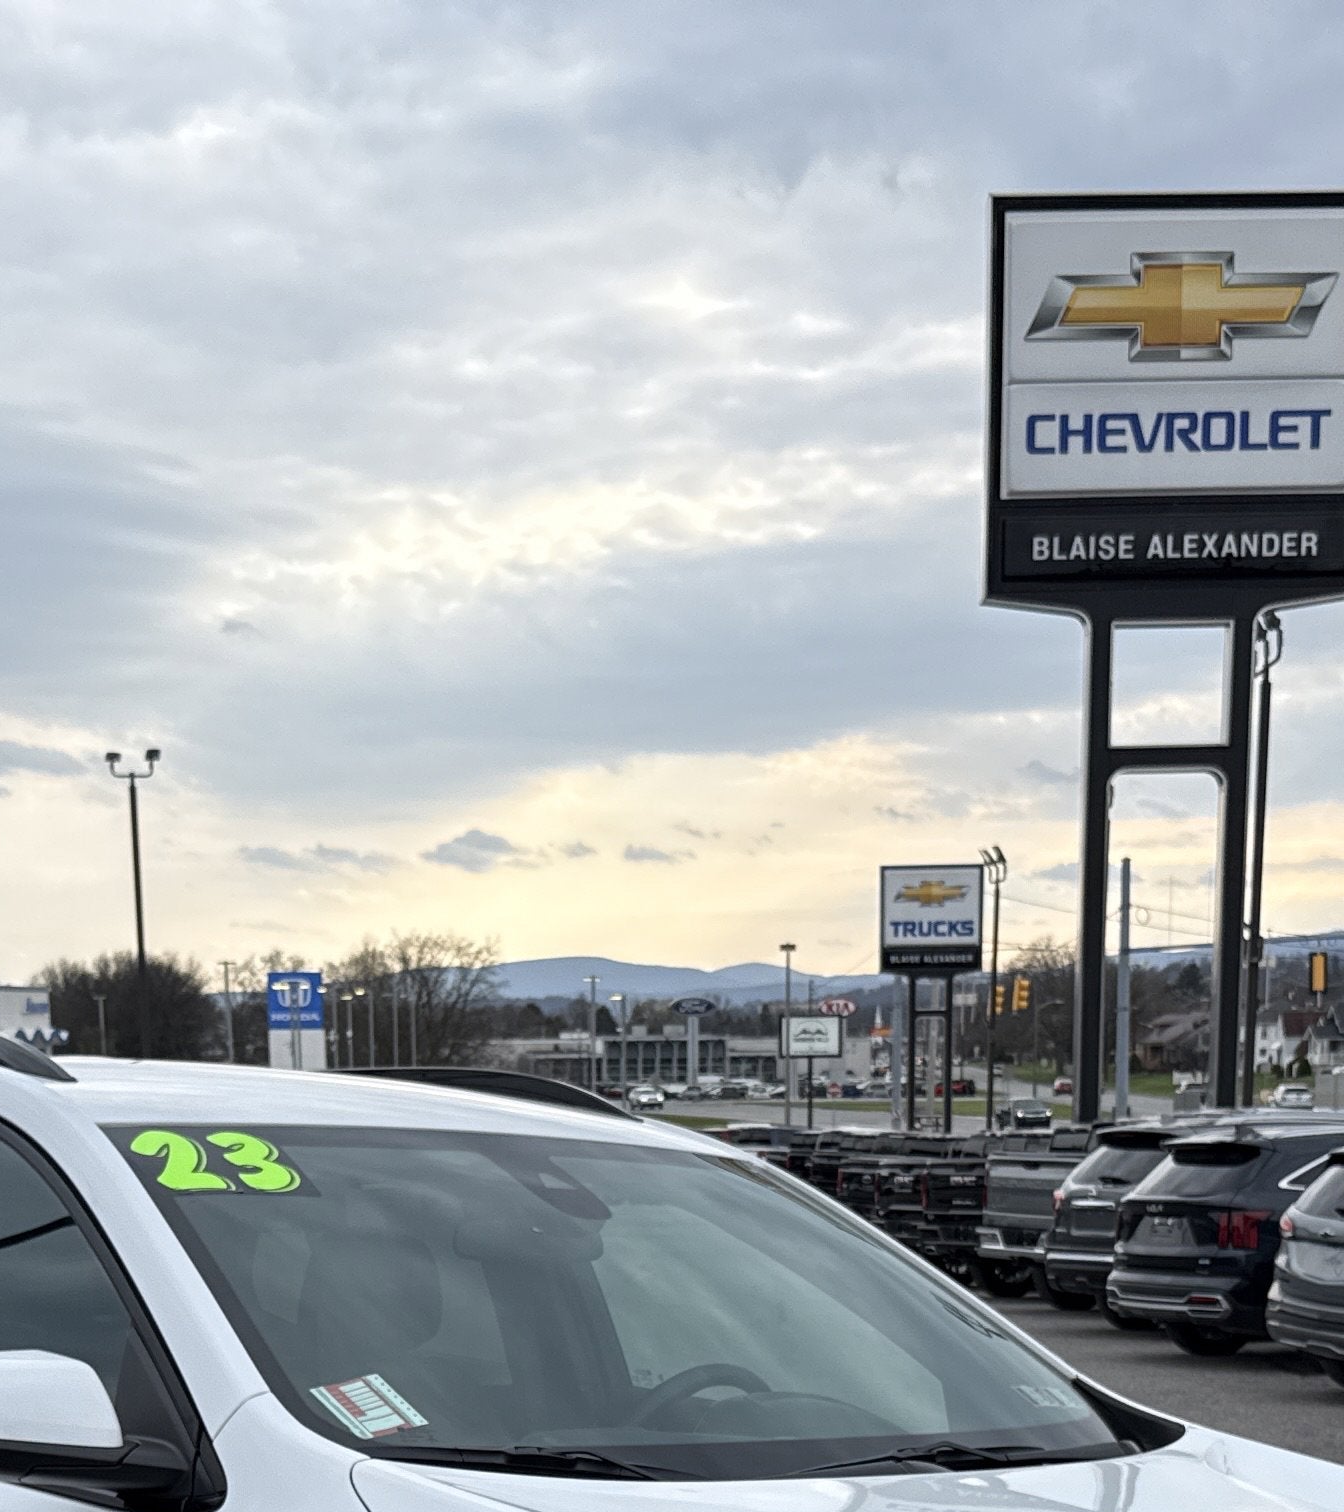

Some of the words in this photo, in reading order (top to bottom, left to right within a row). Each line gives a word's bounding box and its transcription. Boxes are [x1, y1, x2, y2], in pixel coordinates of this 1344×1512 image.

[1025, 410, 1331, 454] CHEVROLET
[1032, 533, 1135, 561] BLAISE
[1147, 532, 1318, 560] ALEXANDER
[890, 920, 974, 938] TRUCKS
[129, 1128, 301, 1194] 23
